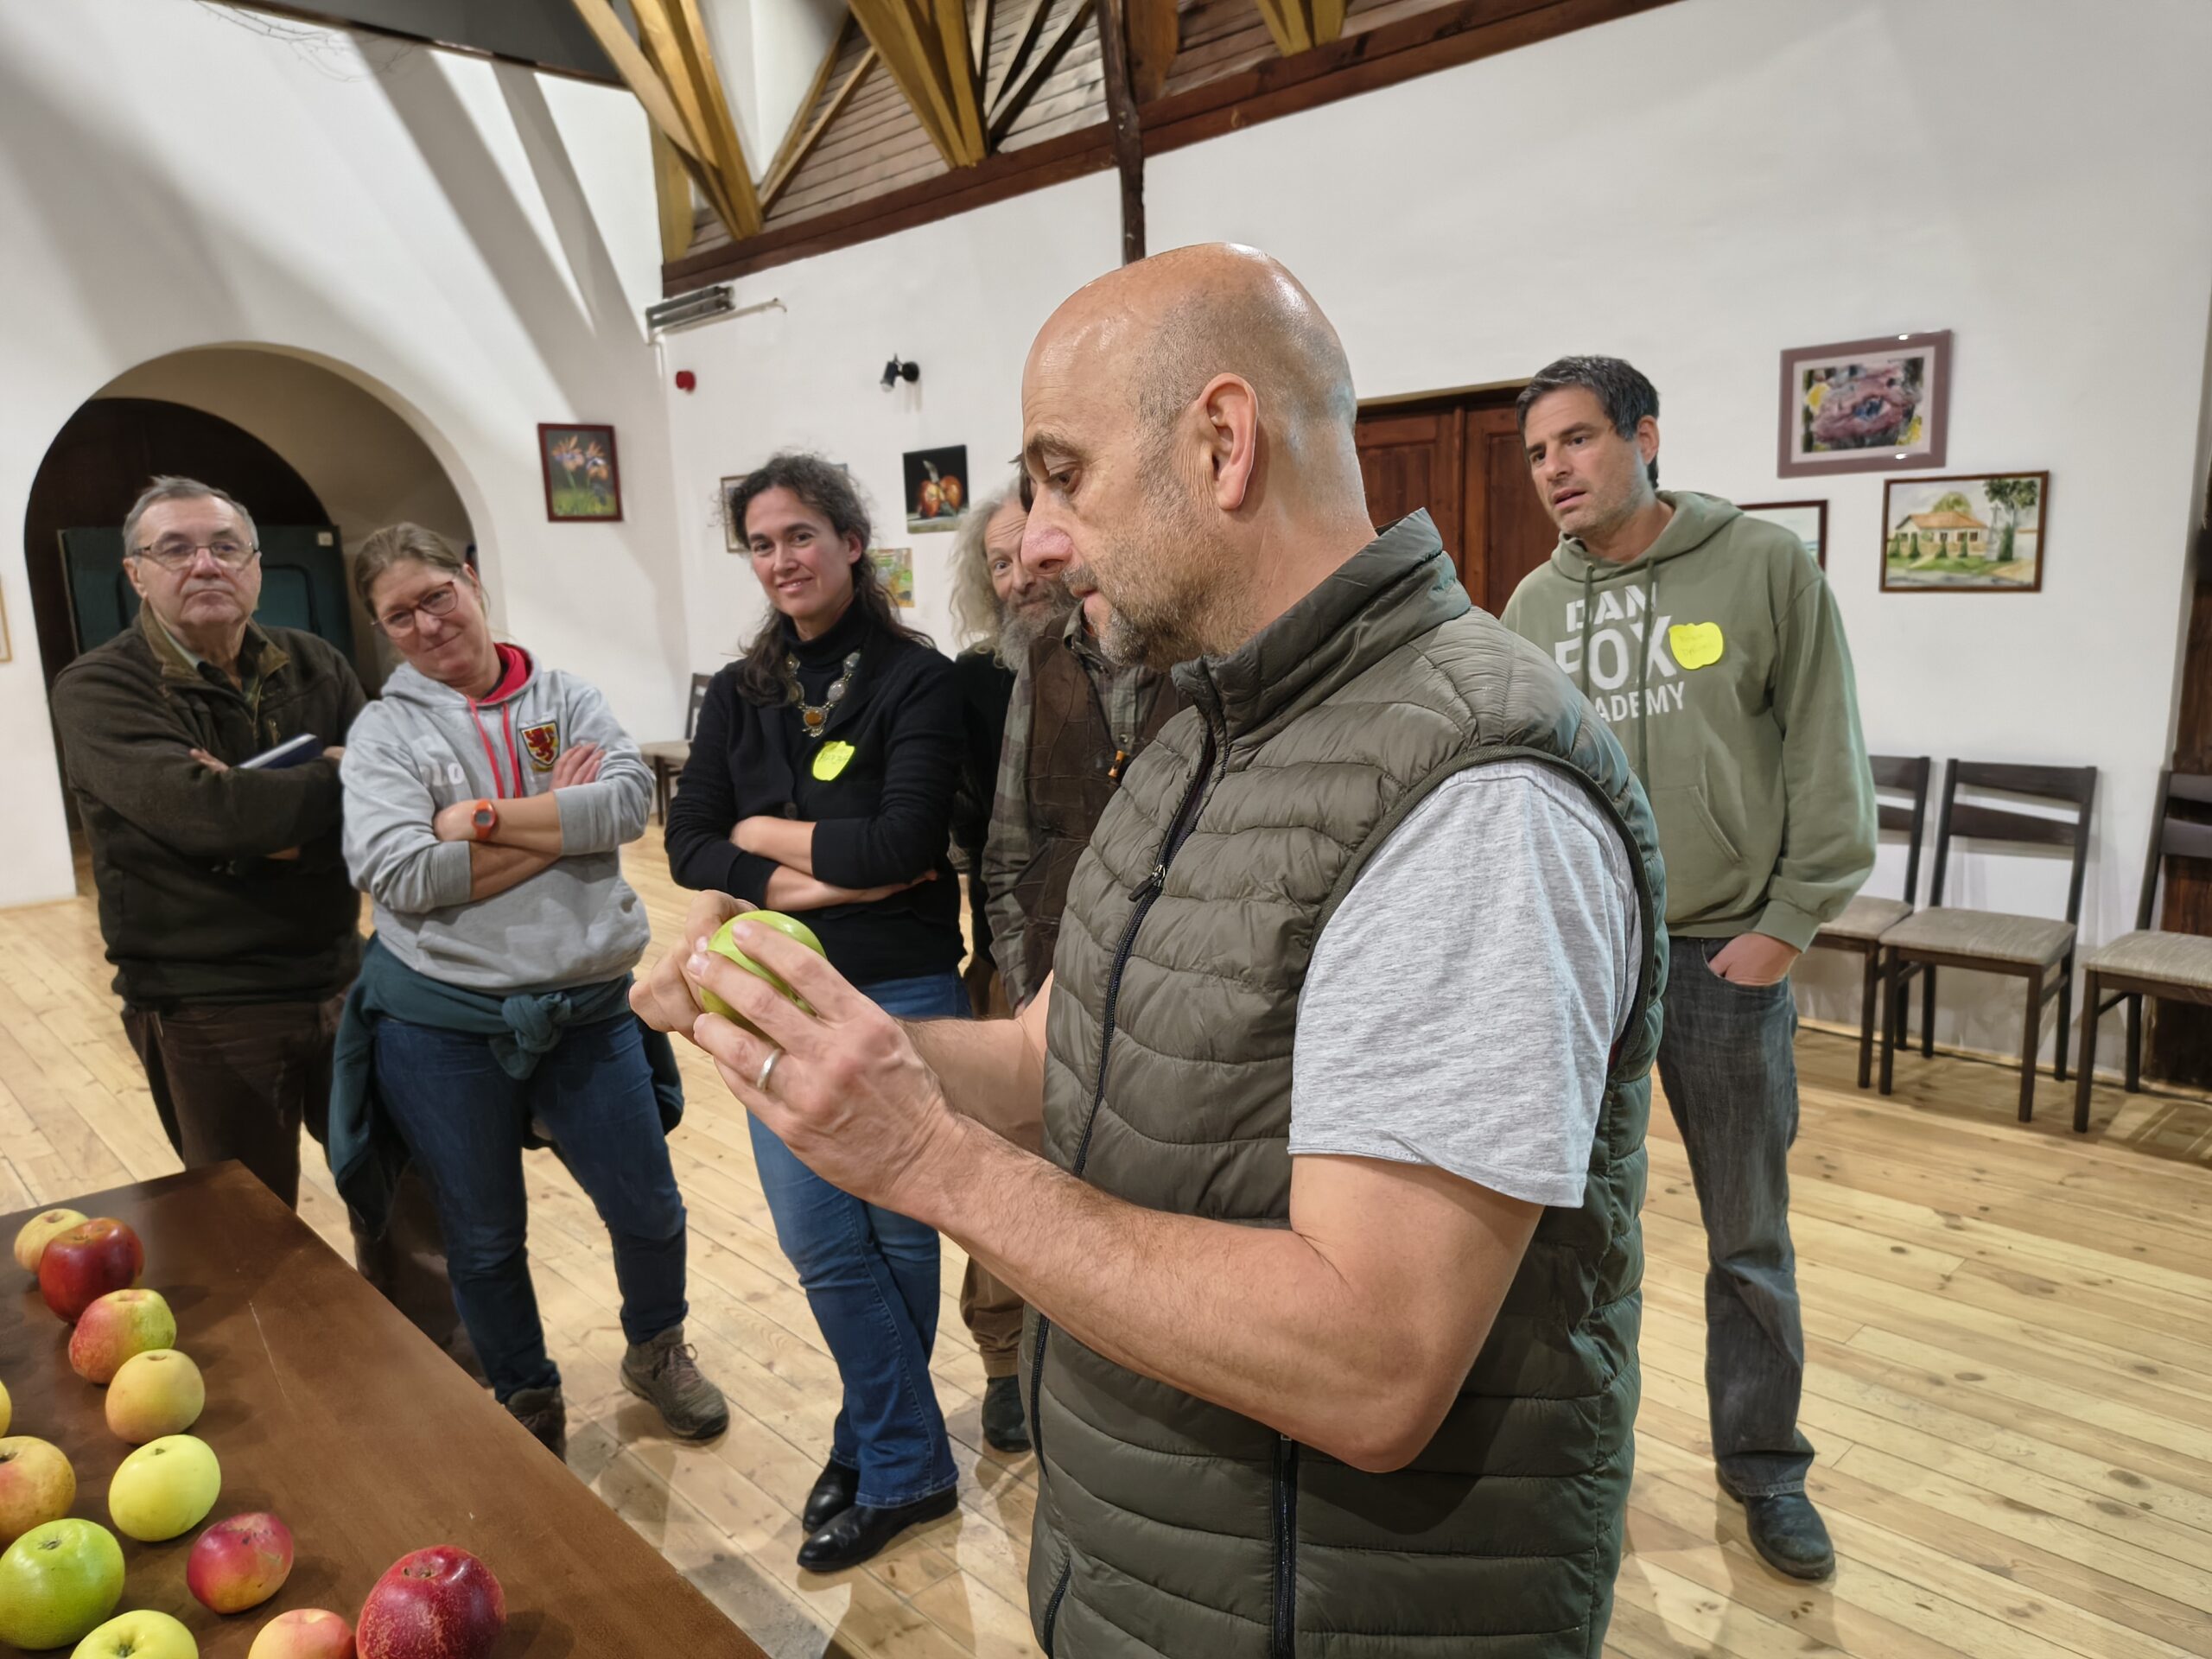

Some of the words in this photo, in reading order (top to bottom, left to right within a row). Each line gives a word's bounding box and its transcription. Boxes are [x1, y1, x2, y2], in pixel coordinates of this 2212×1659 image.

[1566, 582, 1657, 632] DAN
[1554, 615, 1677, 690] FOX
[1594, 681, 1685, 722] ADEMY
